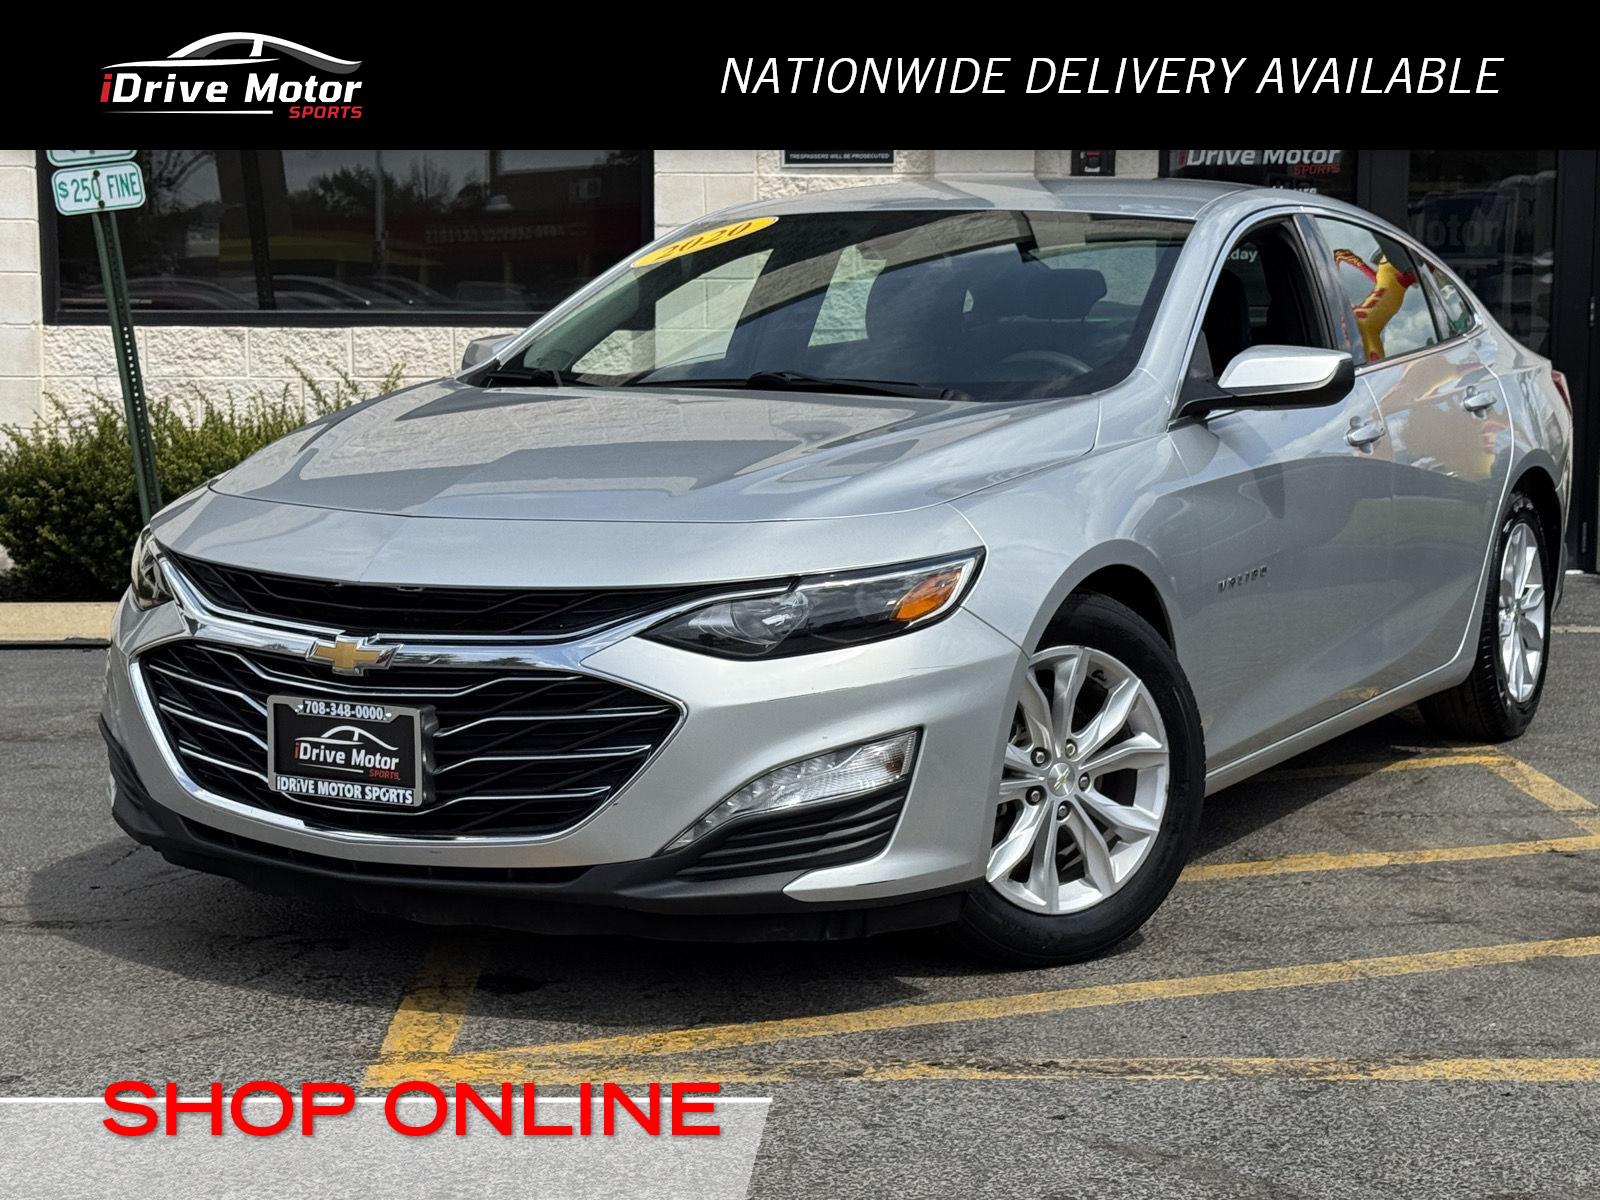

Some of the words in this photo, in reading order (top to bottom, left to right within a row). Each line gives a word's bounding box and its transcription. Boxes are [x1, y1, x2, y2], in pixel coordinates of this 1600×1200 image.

[789, 152, 829, 160] TRESPASSERS
[830, 152, 842, 160] WILL
[843, 152, 851, 160] BE
[852, 152, 890, 160] PROSECUTED
[1262, 150, 1342, 166] Motor
[106, 172, 141, 199] FINE
[655, 222, 752, 261] 2020
[305, 700, 384, 720] 708-348-0000
[294, 741, 346, 765] iDrive
[351, 748, 400, 770] Motor
[368, 768, 400, 781] SPORTS
[317, 780, 363, 799] MOTOR
[365, 786, 413, 804] SPORTS
